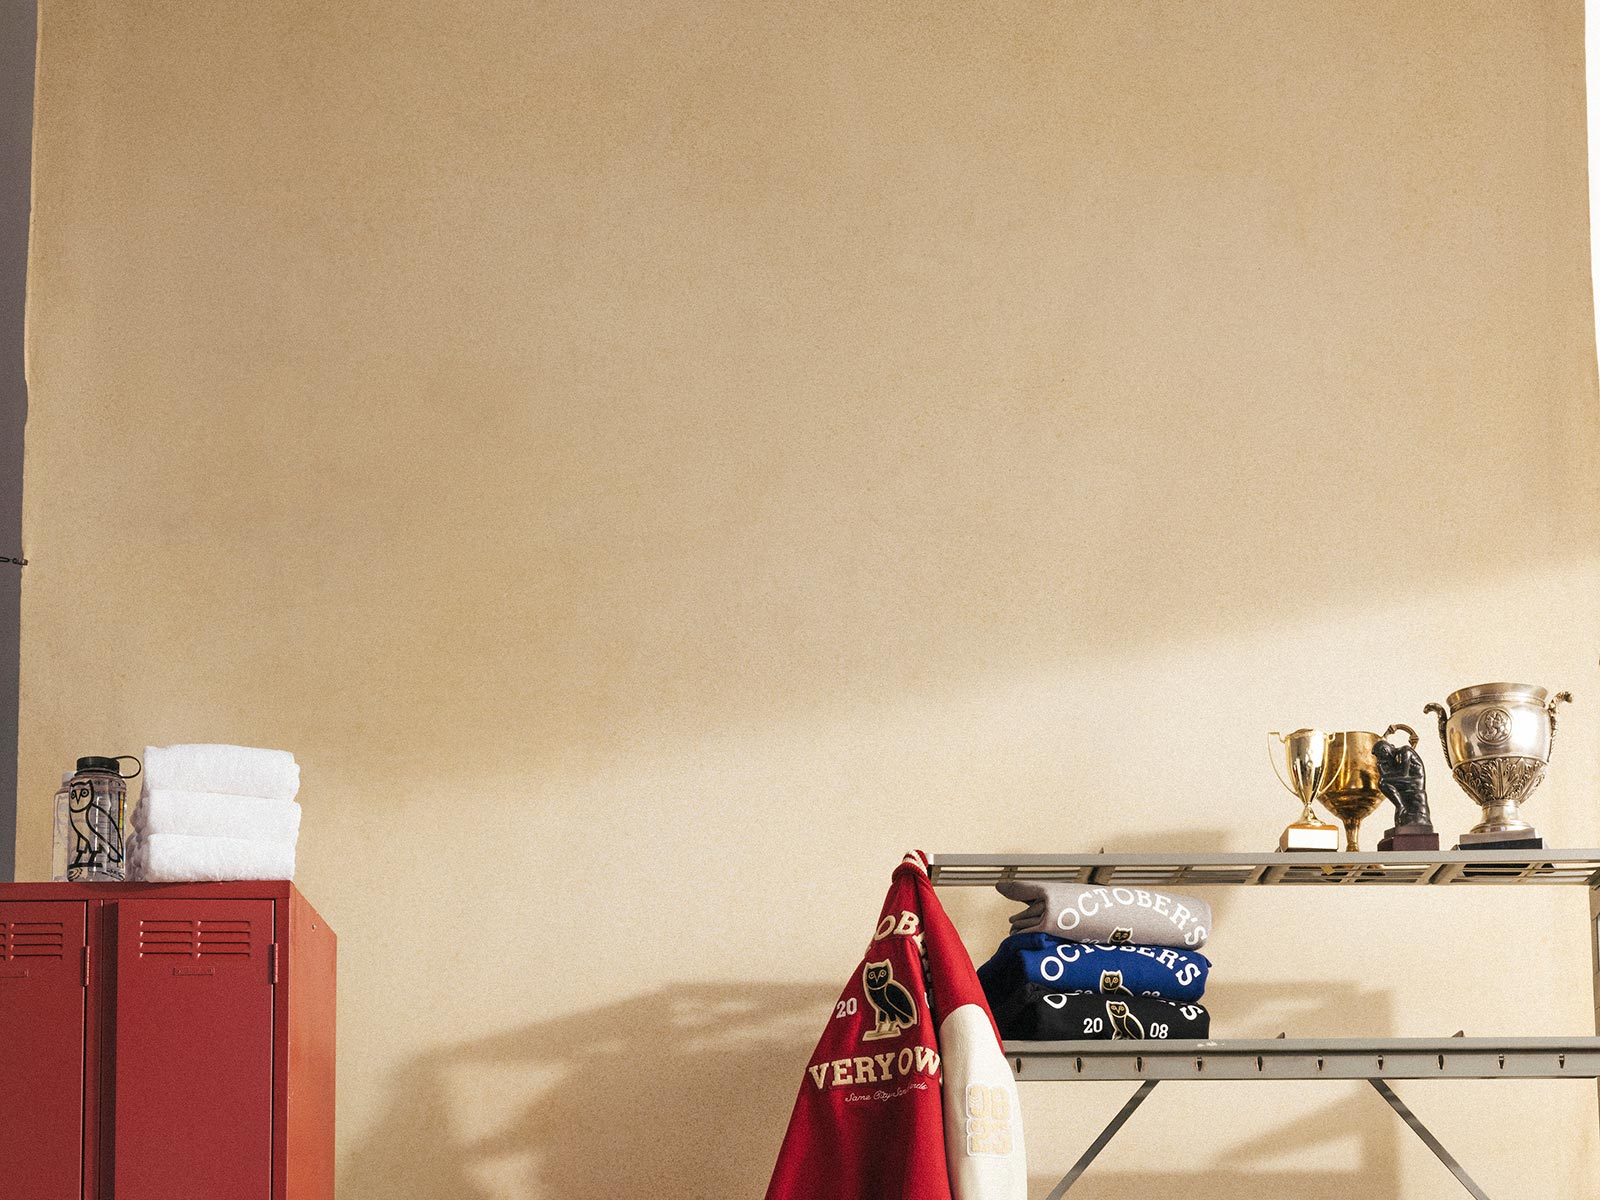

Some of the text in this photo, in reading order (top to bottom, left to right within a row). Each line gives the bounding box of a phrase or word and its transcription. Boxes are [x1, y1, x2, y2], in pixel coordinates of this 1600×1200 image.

[1057, 887, 1207, 946] OCTOBER'S
[836, 997, 858, 1019] 20
[1083, 1017, 1169, 1040] 20 08
[808, 1045, 942, 1090] VERY OW
